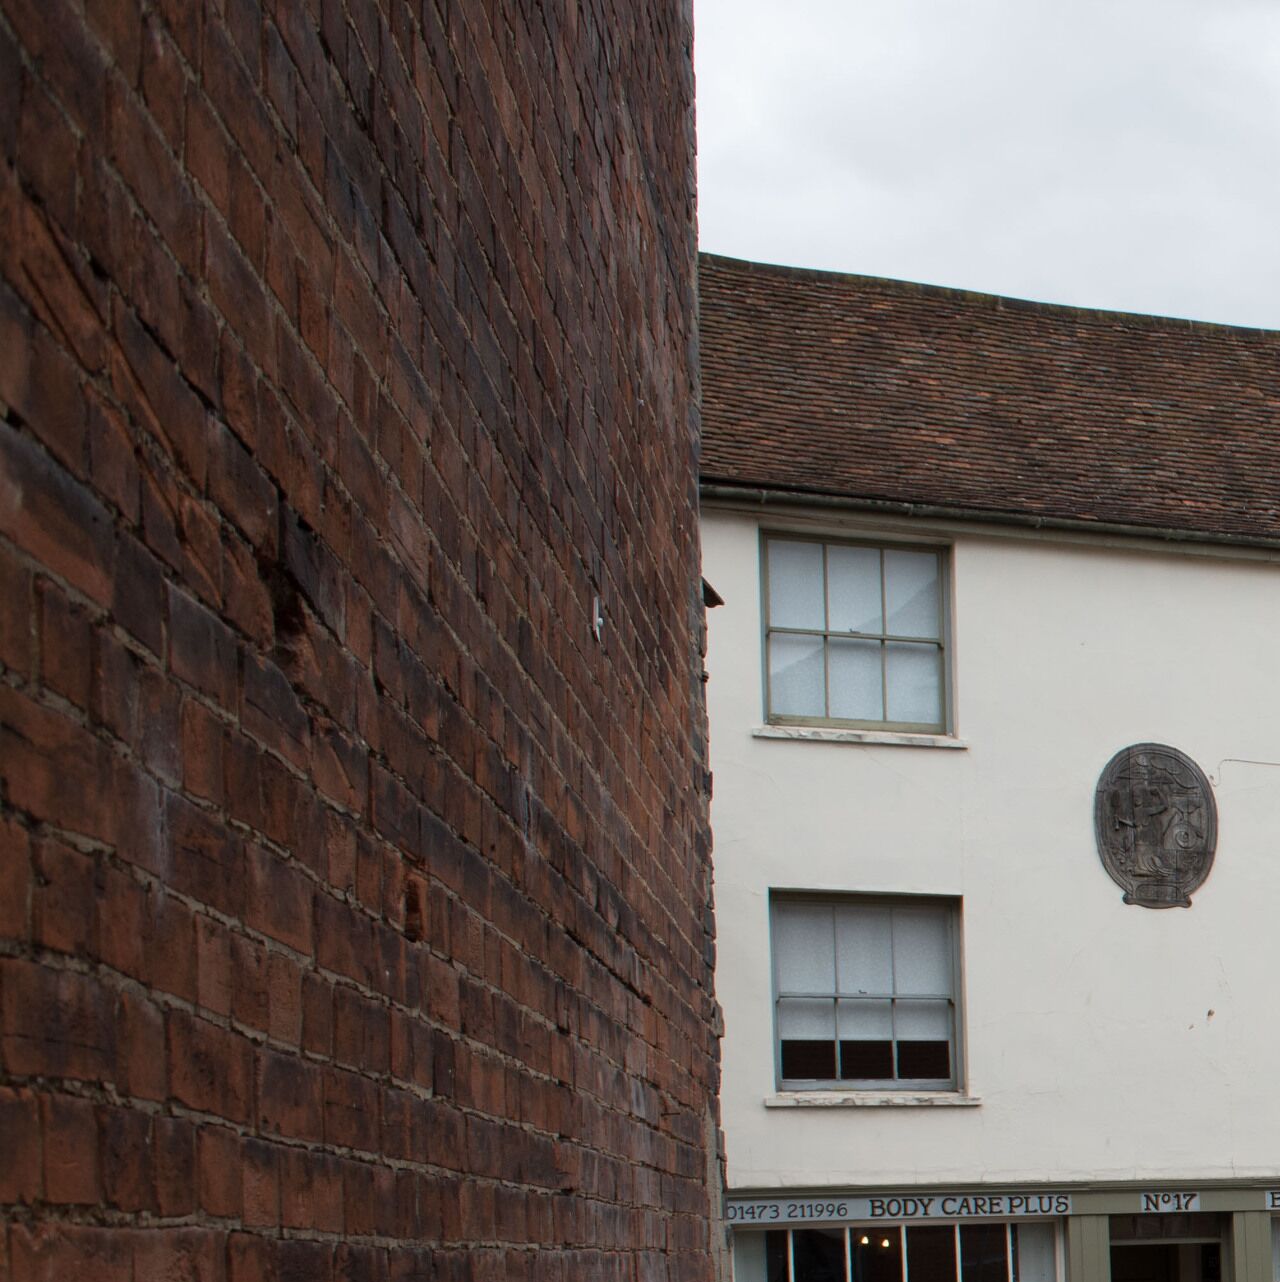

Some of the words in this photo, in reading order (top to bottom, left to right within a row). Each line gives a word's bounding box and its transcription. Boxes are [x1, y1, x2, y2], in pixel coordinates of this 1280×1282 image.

[727, 1204, 780, 1220] 01473
[787, 1203, 848, 1218] 211996
[869, 1198, 934, 1217] BODY
[941, 1197, 1003, 1215] CARE
[1008, 1195, 1070, 1214] PLUS
